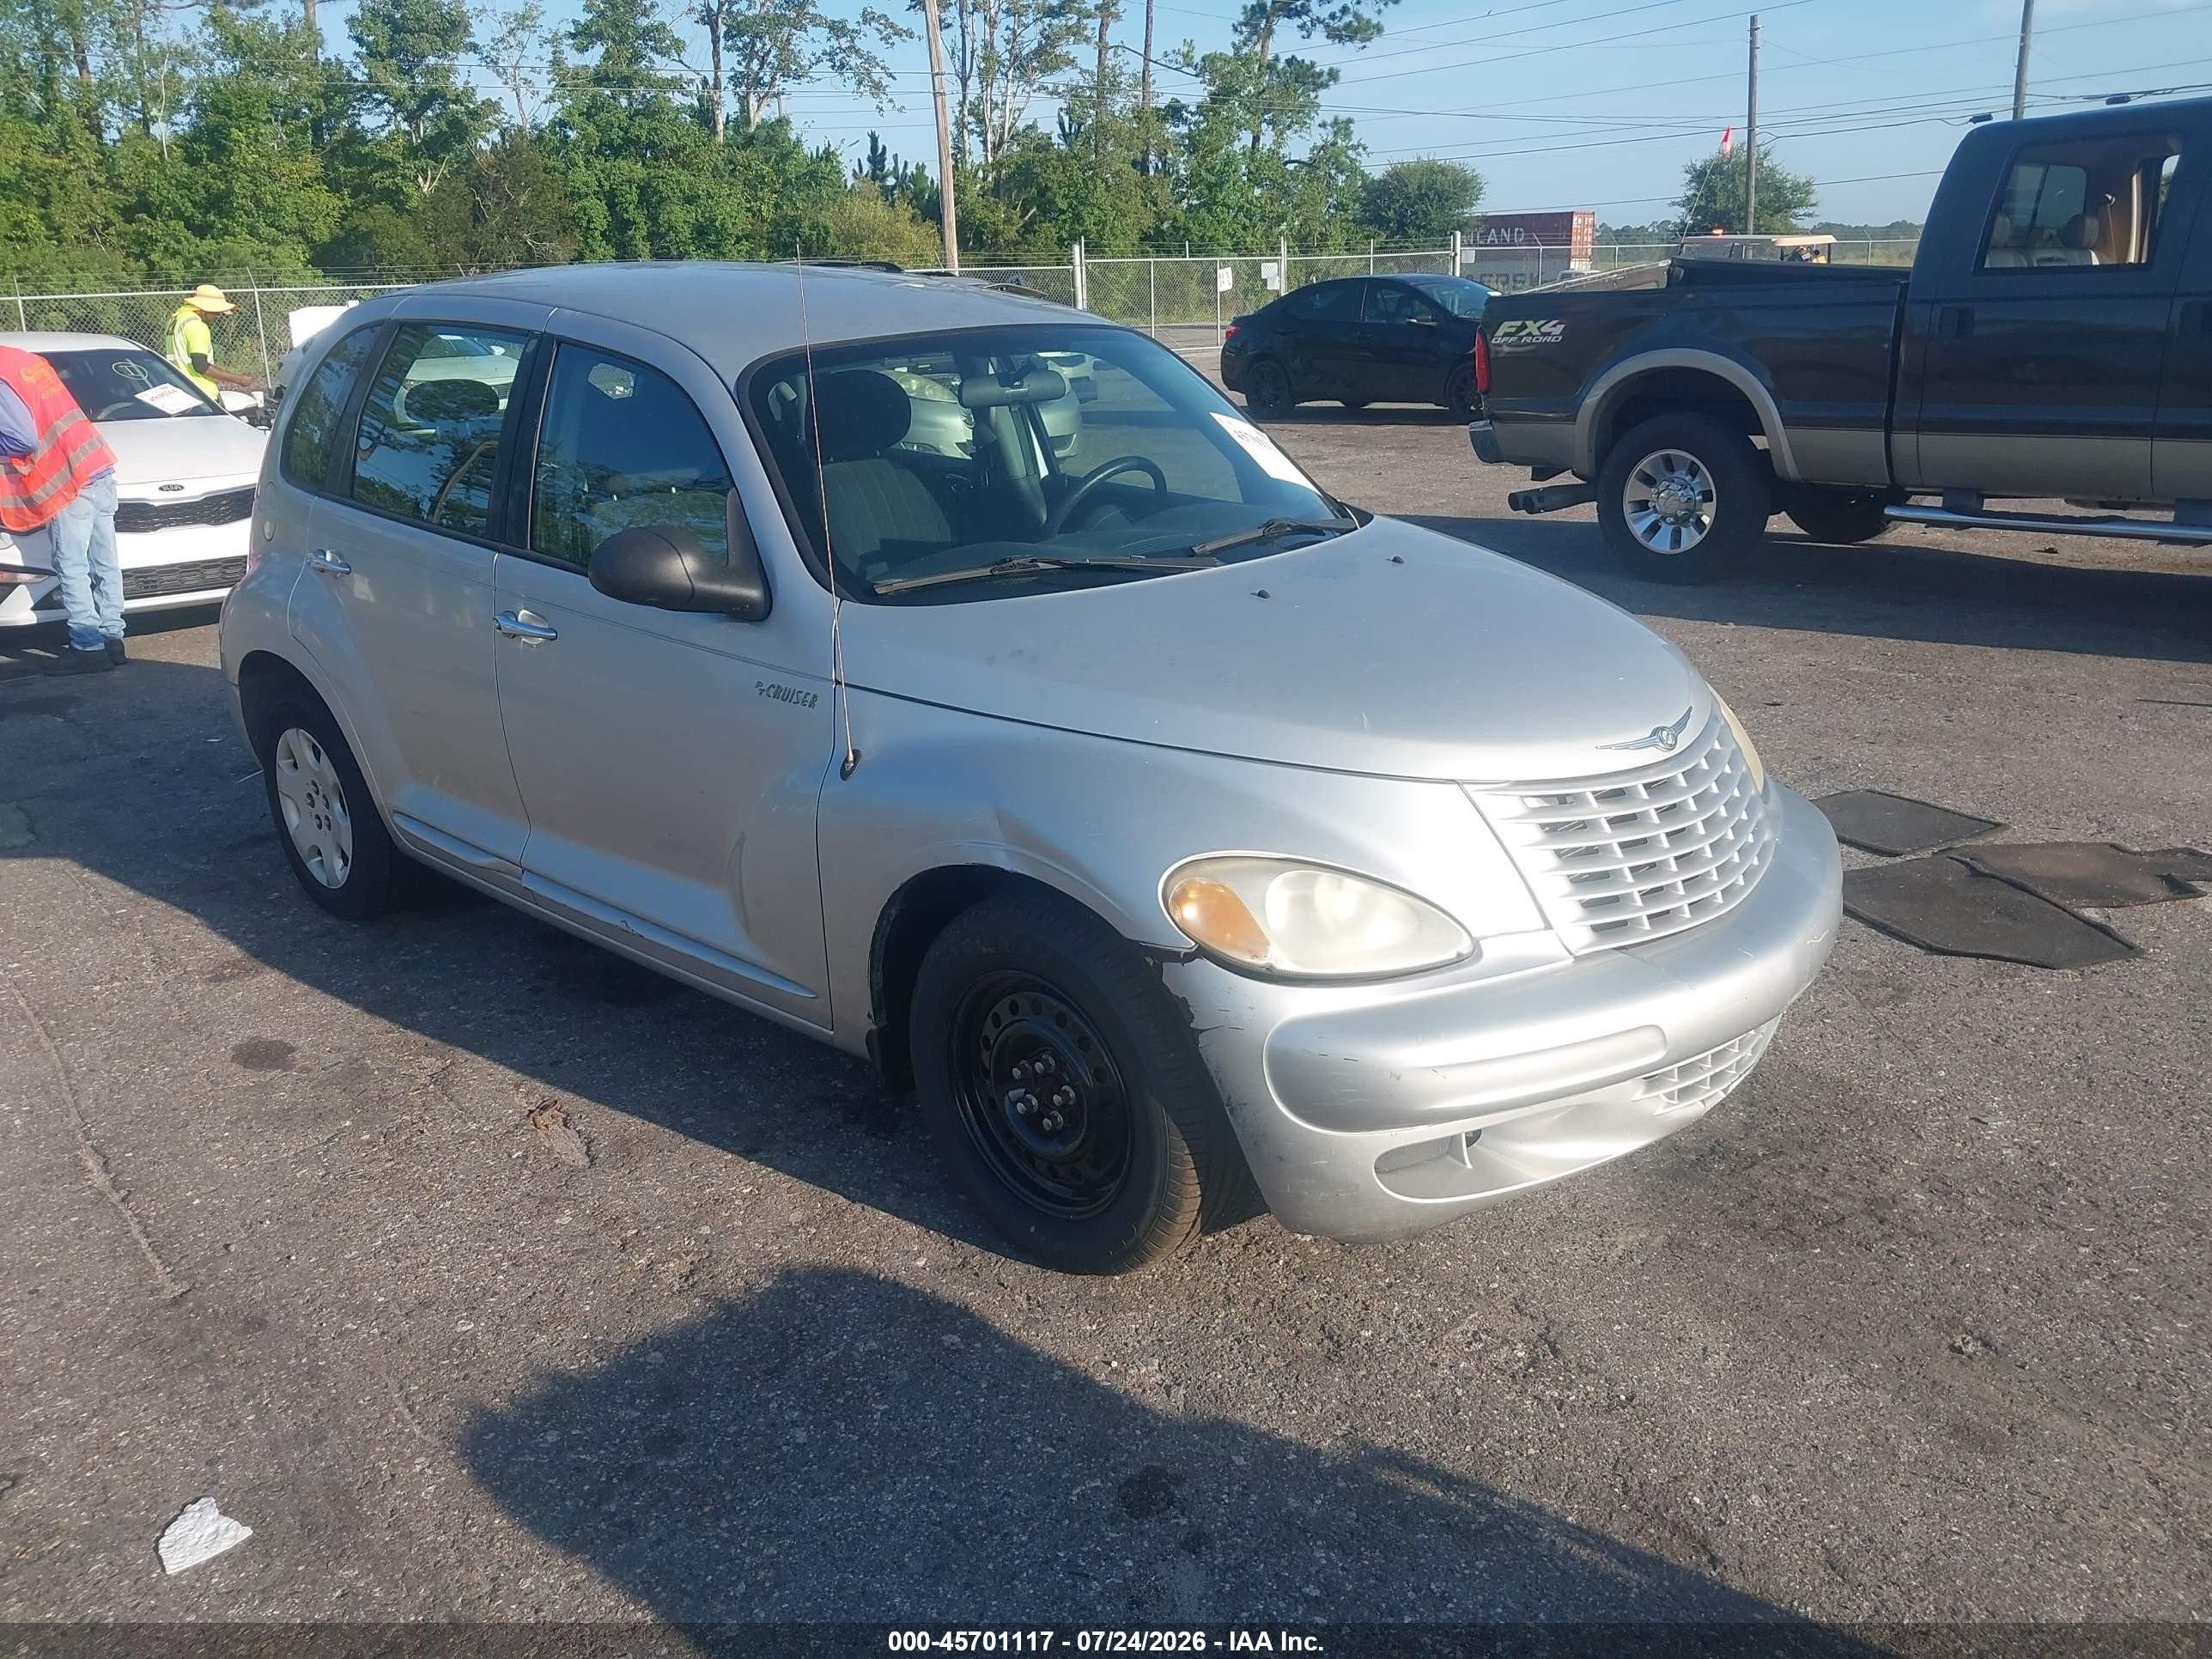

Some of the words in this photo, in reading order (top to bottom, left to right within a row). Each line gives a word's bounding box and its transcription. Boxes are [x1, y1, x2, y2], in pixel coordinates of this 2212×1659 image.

[1494, 319, 1566, 337] FX4
[1491, 336, 1519, 344] OFF
[765, 684, 818, 709] CRUISER
